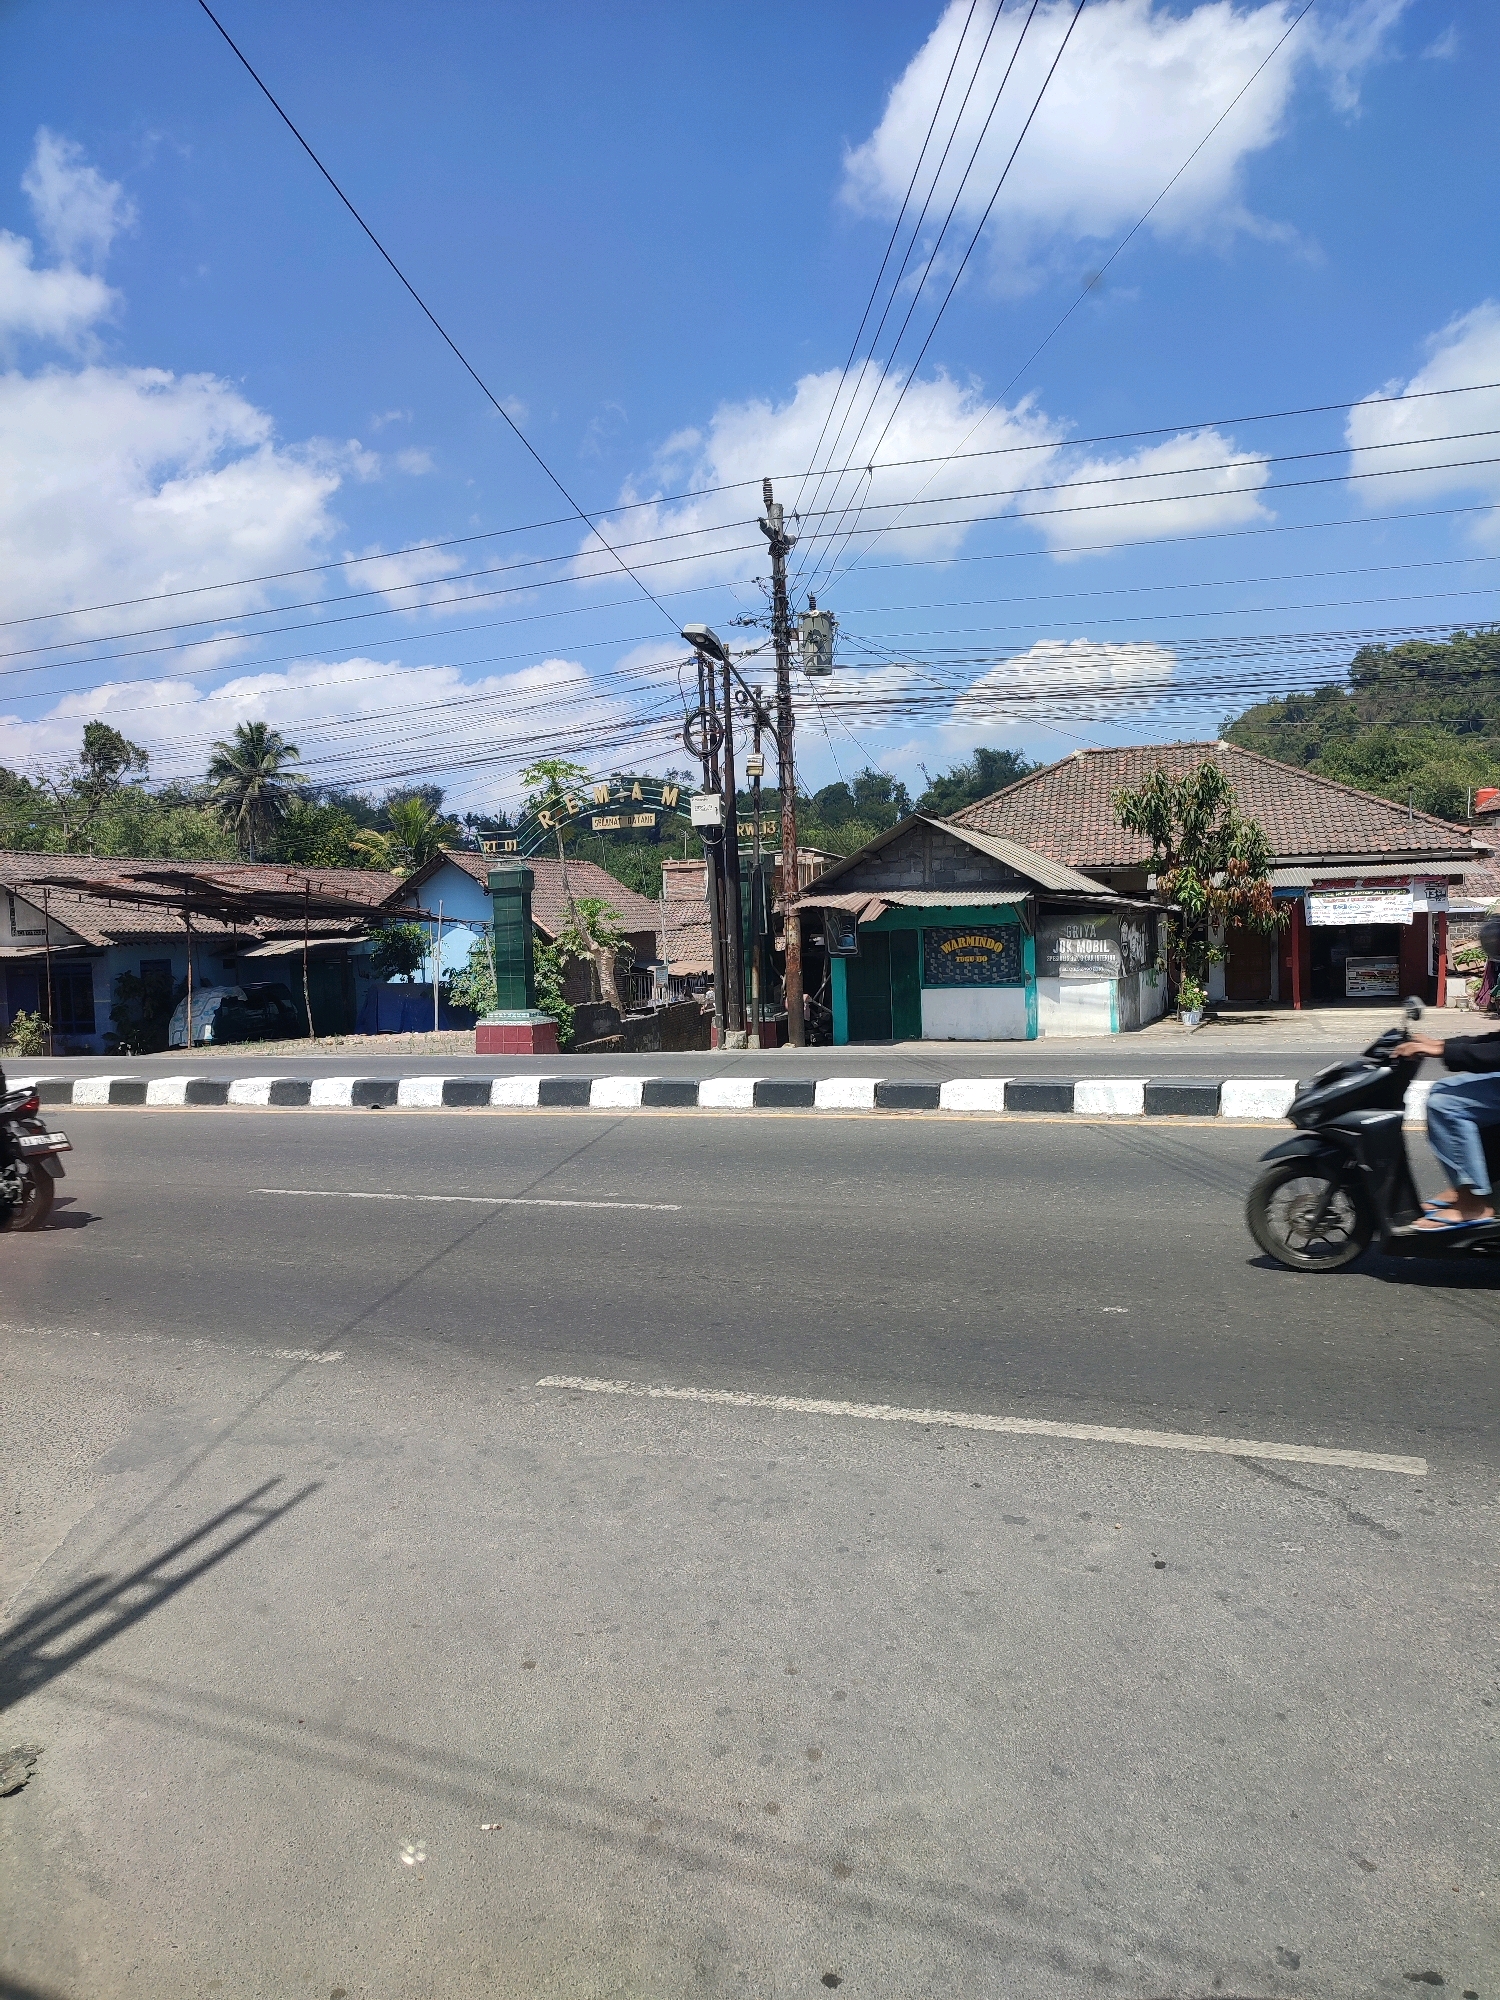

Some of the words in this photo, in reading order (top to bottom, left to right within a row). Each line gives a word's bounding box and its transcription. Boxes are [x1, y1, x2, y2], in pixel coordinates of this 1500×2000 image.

[594, 816, 621, 828] SELAMAT
[737, 822, 755, 837] RW
[484, 841, 497, 854] RT
[1066, 924, 1097, 938] GRIYA
[940, 935, 1004, 954] WARMINDO
[1052, 939, 1074, 954] JOK
[1076, 939, 1110, 954] MOBIL
